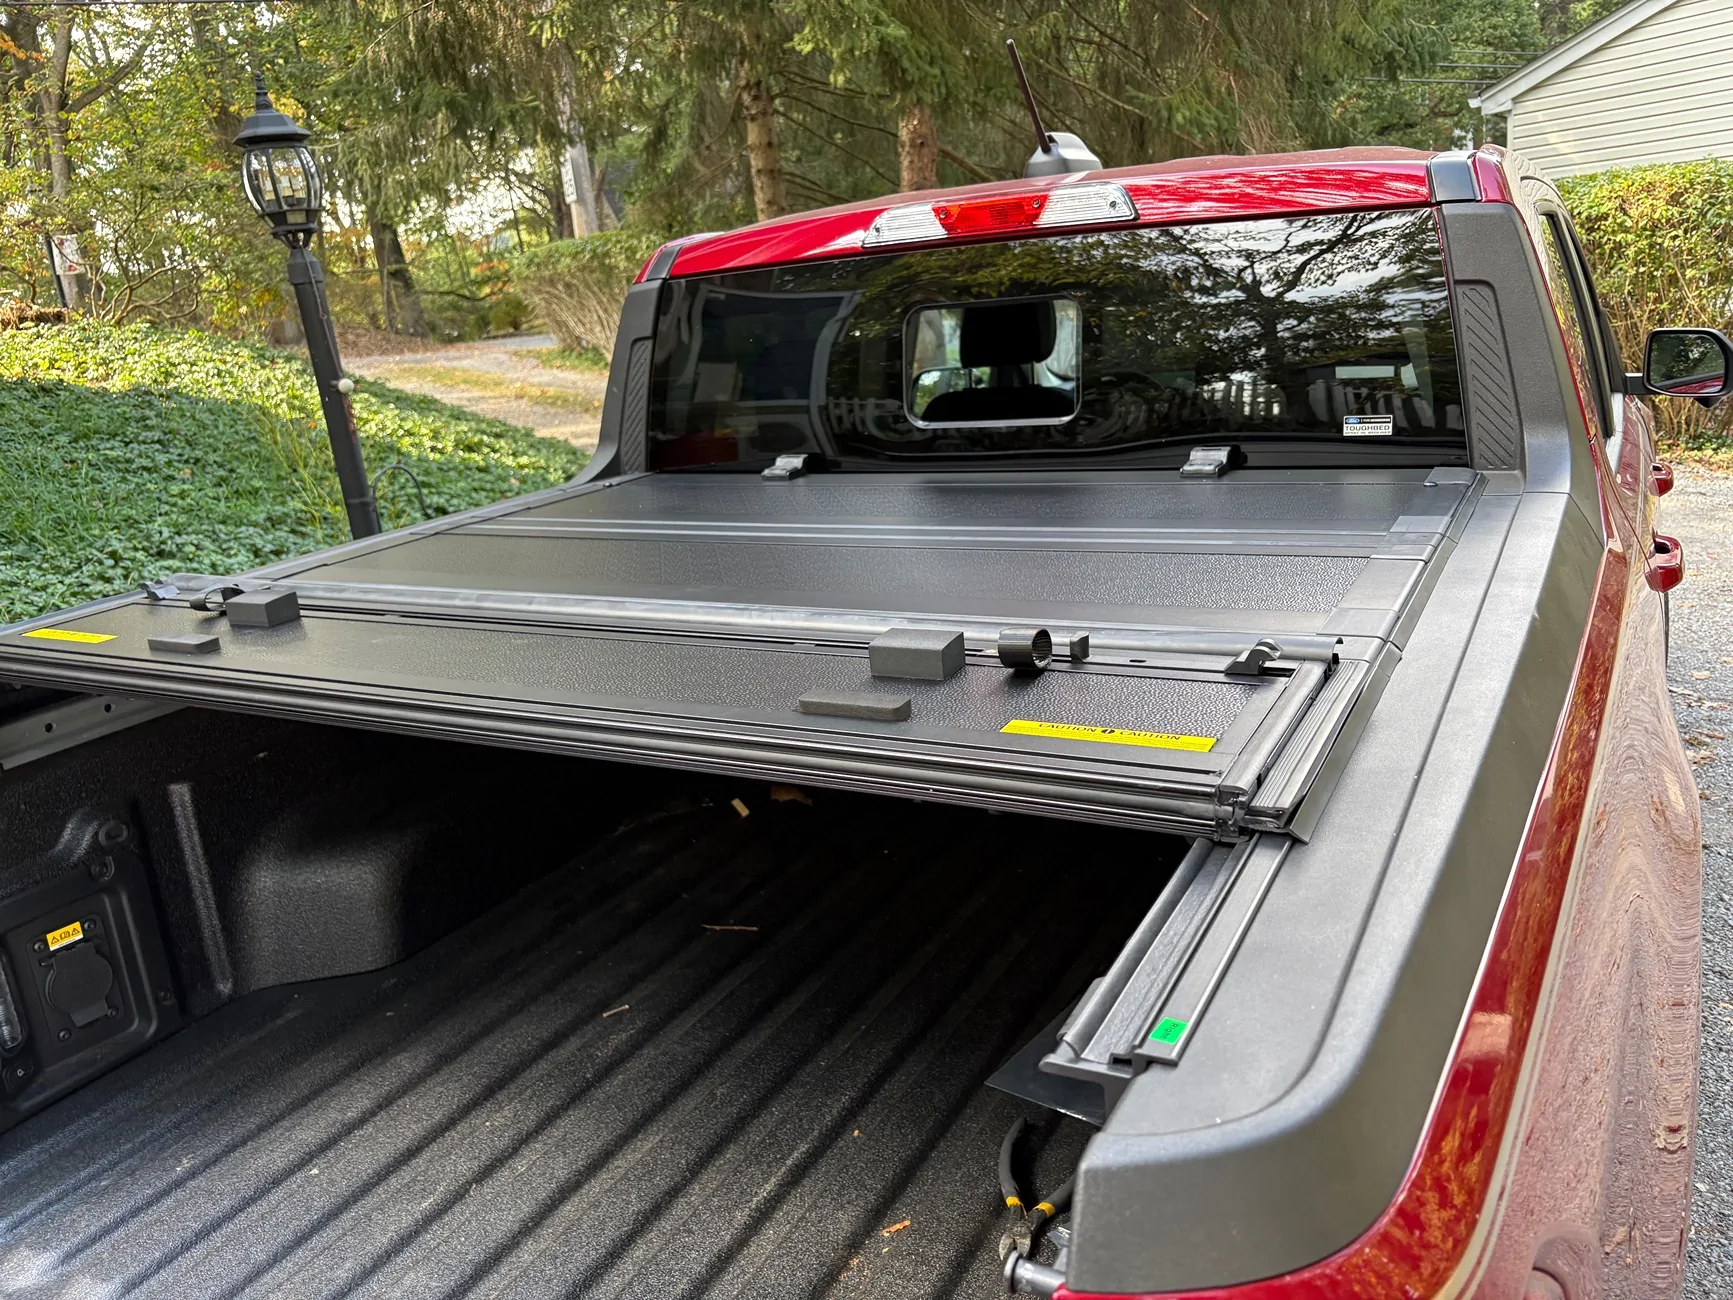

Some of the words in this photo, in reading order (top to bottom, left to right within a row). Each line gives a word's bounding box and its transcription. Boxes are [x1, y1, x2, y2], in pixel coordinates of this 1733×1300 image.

[1344, 424, 1391, 432] TOUGHBED
[1039, 723, 1097, 733] CAUTION
[1120, 730, 1181, 741] CAUTION
[1161, 1022, 1179, 1040] Right
